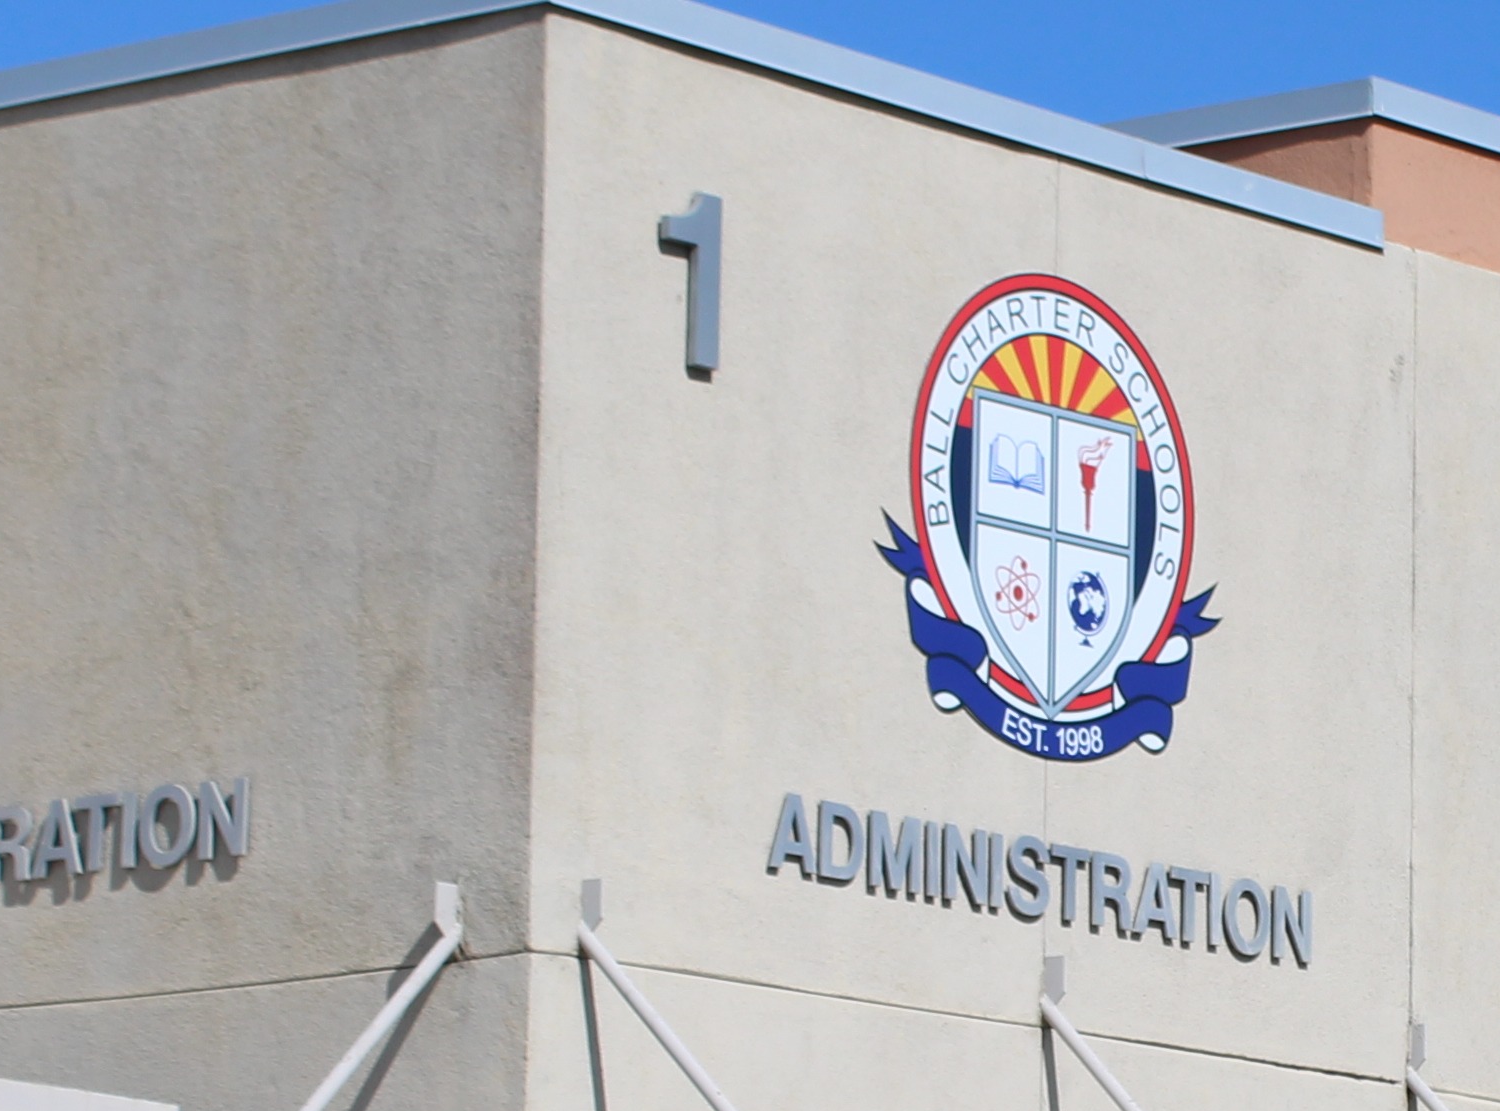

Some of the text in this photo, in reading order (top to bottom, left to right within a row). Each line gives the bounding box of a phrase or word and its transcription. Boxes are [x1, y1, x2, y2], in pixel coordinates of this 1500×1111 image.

[657, 190, 722, 372] 1
[923, 295, 1181, 582] BALL CHARTER SCHOOLS
[1001, 707, 1104, 757] EST. 1998
[766, 793, 1314, 969] ADMINISTRATION
